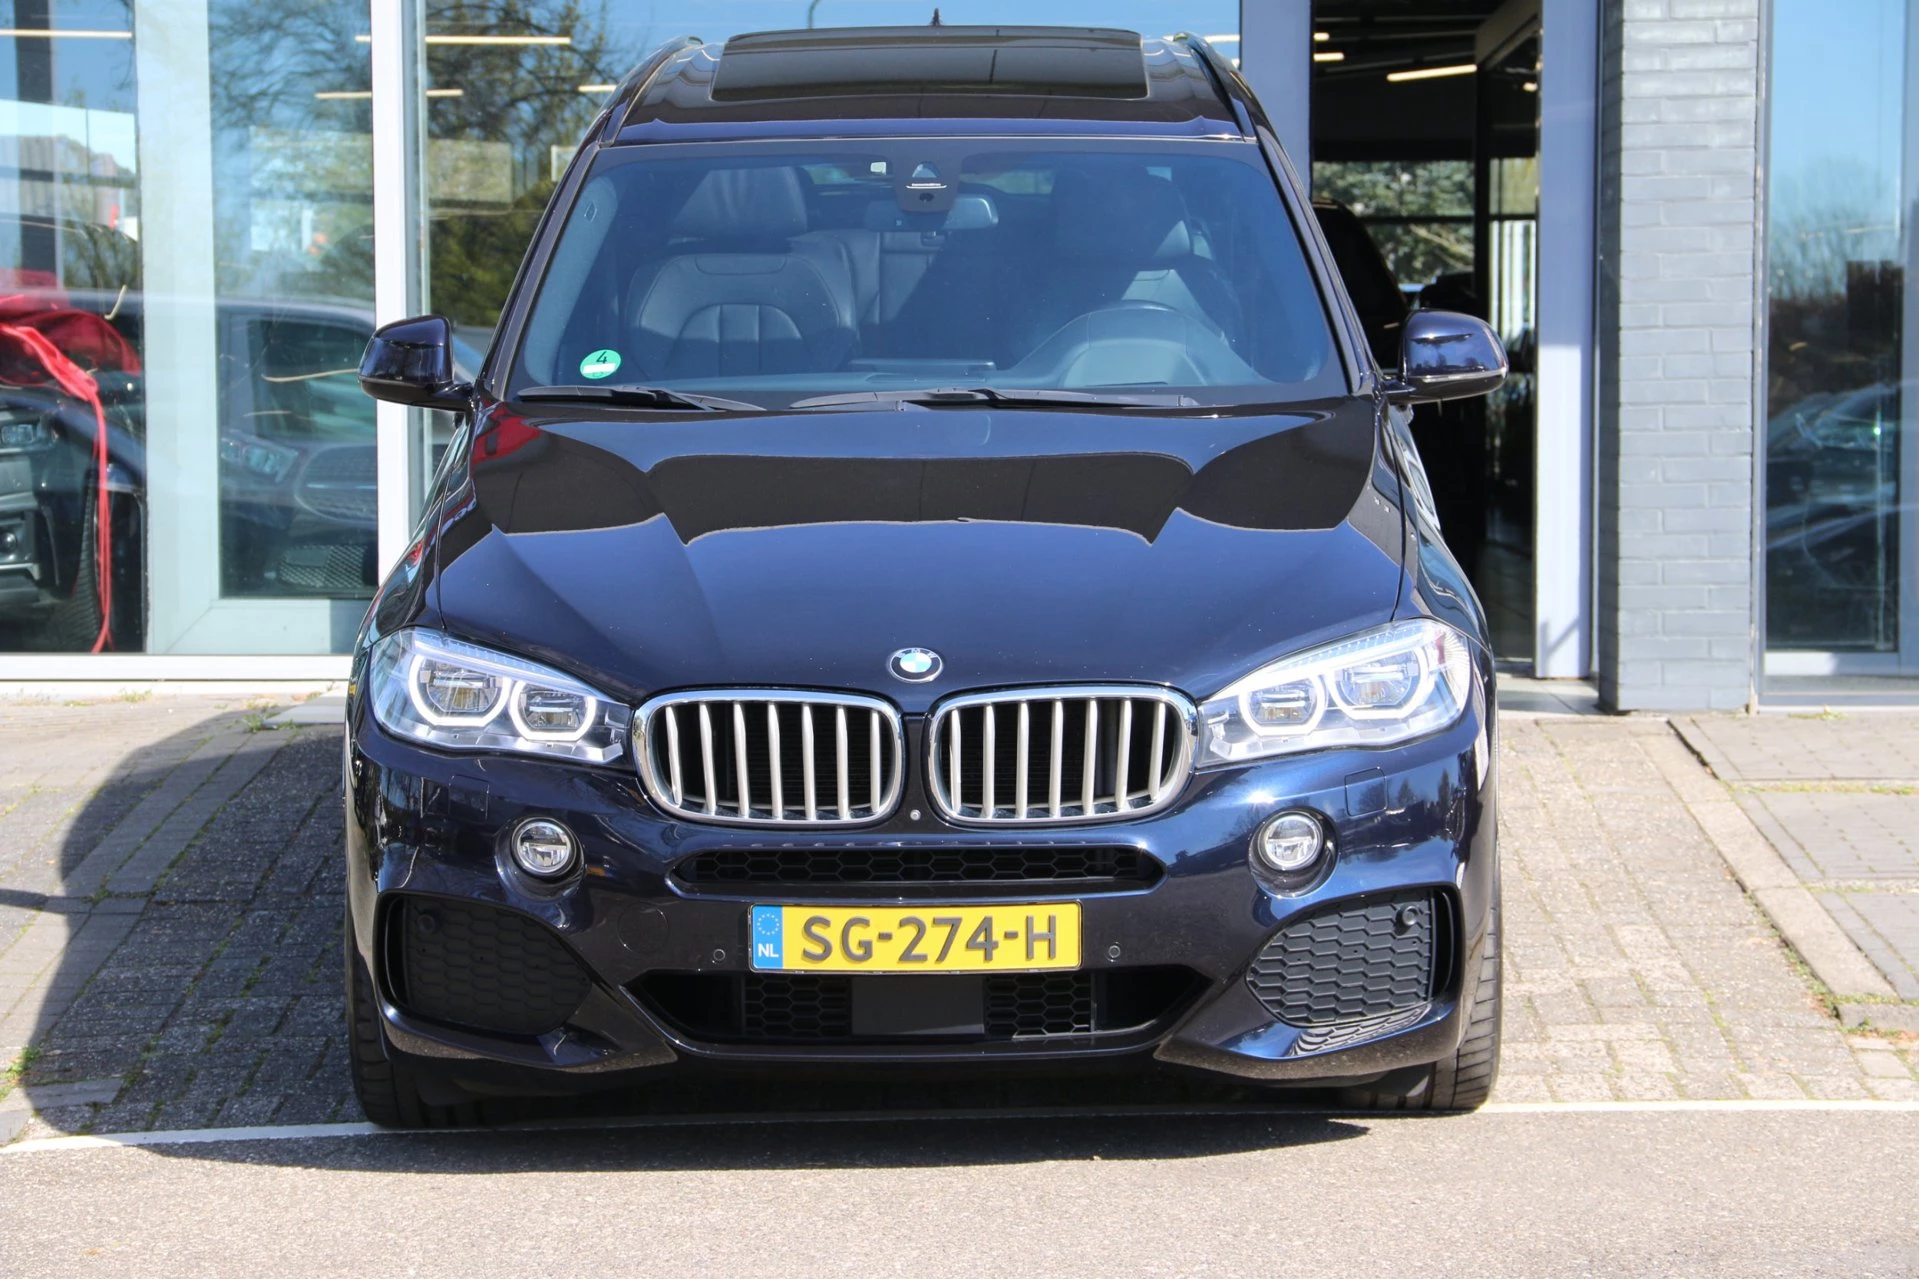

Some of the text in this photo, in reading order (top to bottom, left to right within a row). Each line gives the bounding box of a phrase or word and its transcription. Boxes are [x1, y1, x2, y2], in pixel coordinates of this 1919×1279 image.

[596, 350, 608, 364] 4
[801, 914, 1057, 962] SG-274-H
[757, 943, 779, 958] NL
